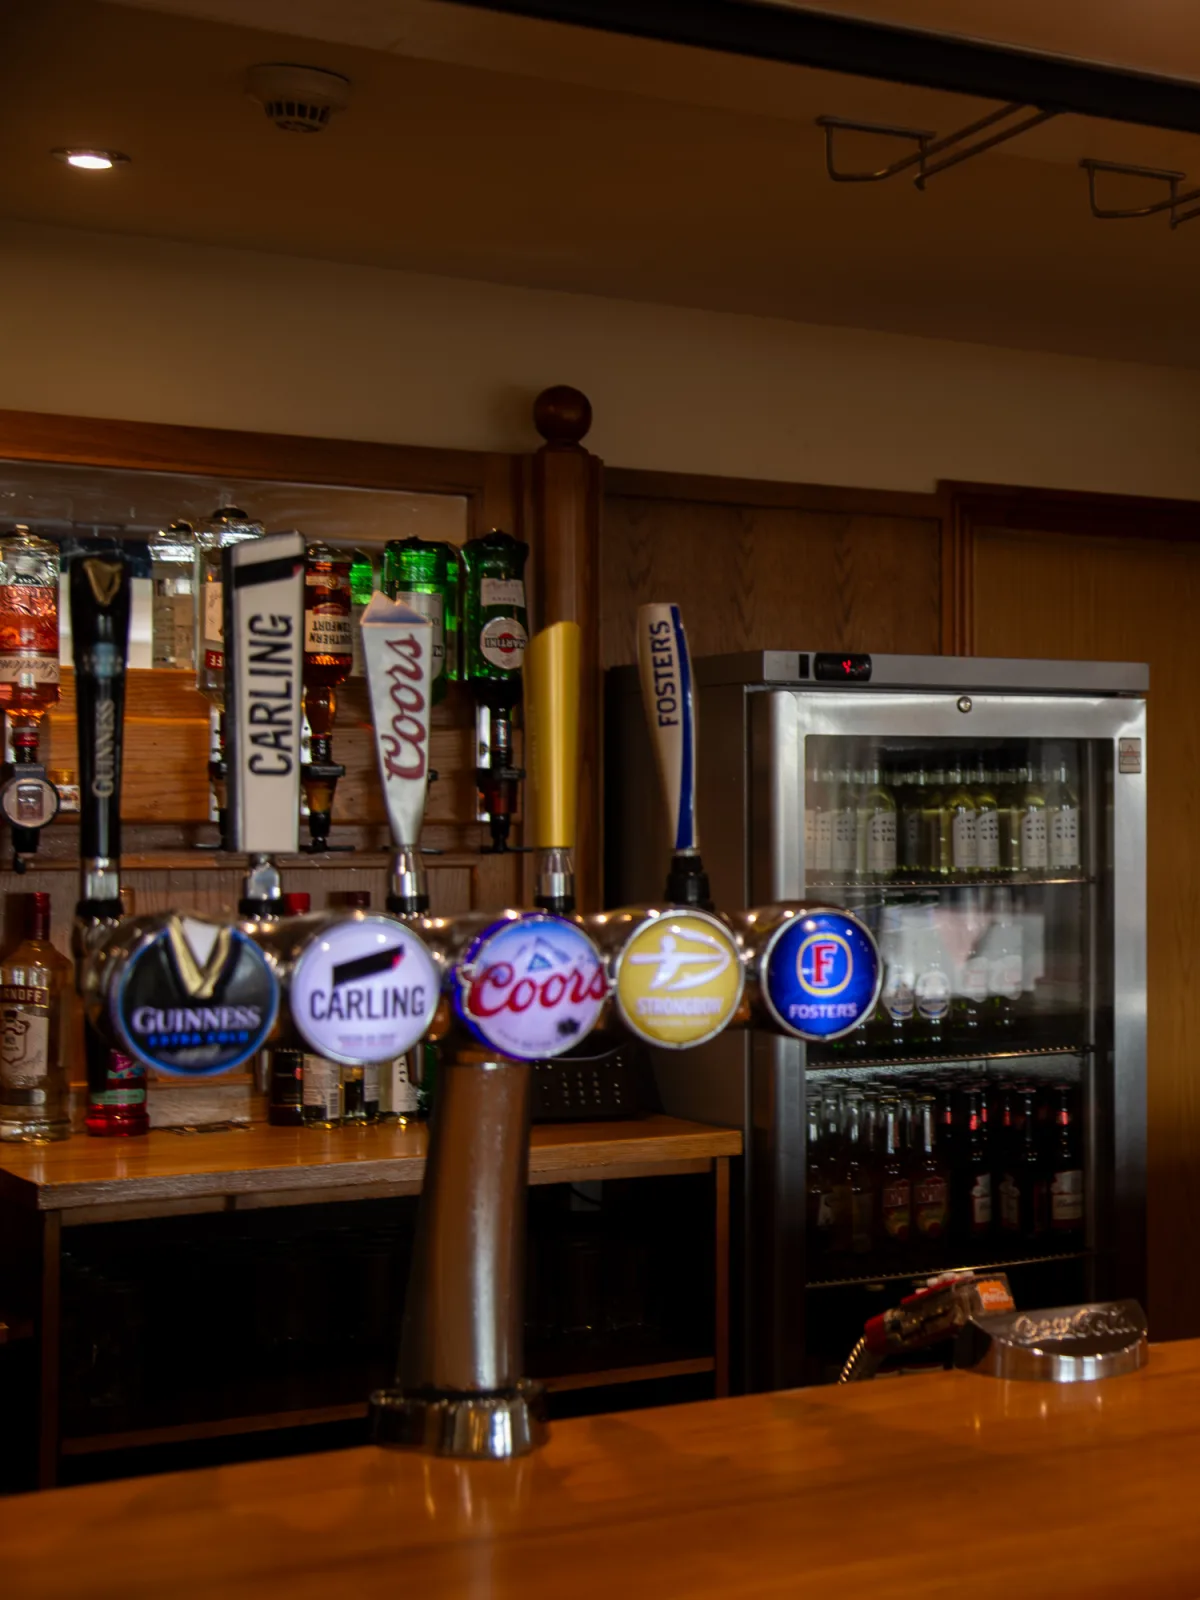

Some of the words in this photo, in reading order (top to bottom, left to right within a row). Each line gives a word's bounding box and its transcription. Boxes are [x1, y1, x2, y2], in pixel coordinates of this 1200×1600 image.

[485, 638, 526, 649] MARTINI
[248, 613, 292, 777] CARLING
[649, 619, 680, 728] FOSTER'S
[381, 632, 426, 781] Coors
[92, 698, 115, 797] GUINNESS
[462, 961, 613, 1017] Coors
[811, 943, 838, 987] F
[131, 1005, 262, 1034] GUINNESS
[309, 985, 425, 1021] CARLING
[636, 996, 724, 1015] STRONGBOW
